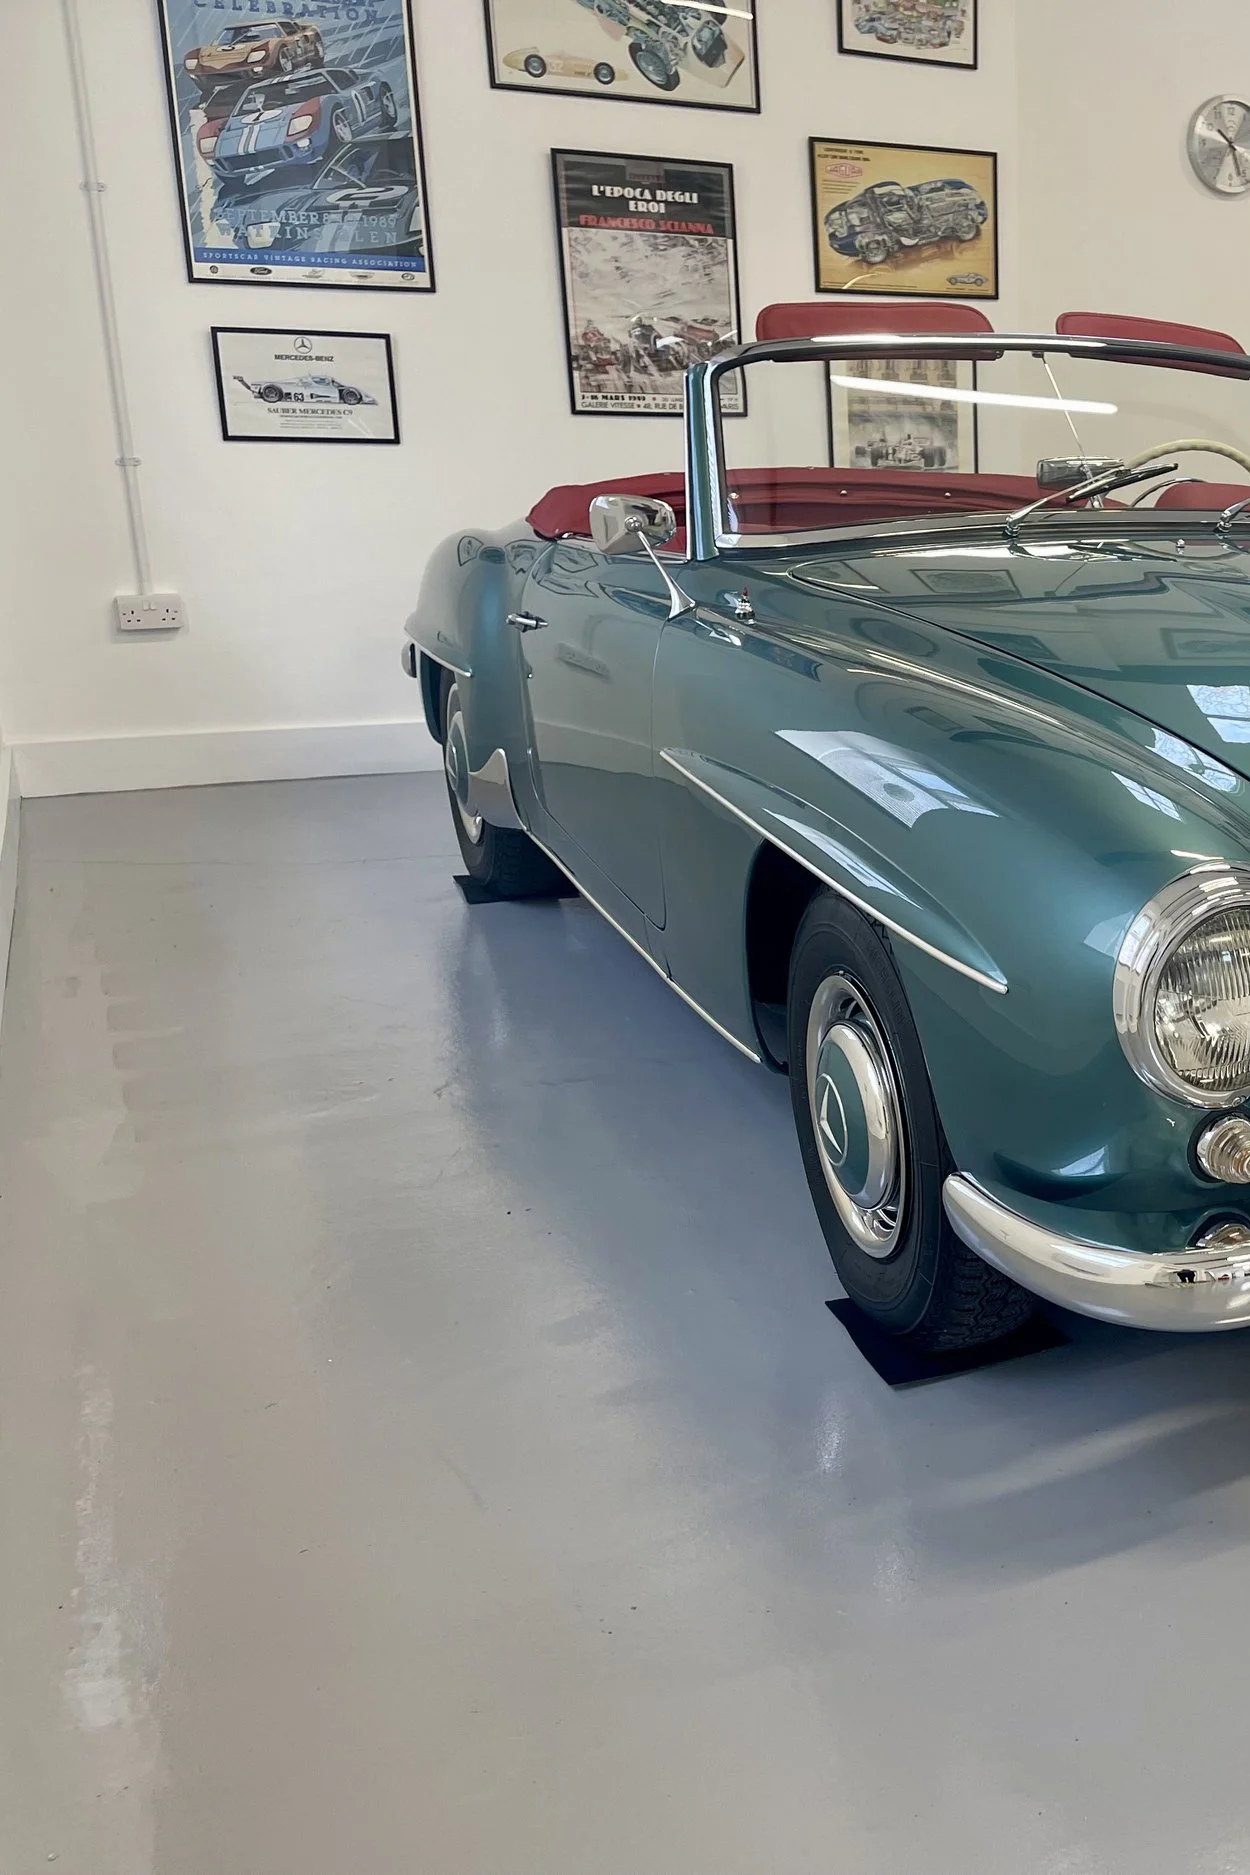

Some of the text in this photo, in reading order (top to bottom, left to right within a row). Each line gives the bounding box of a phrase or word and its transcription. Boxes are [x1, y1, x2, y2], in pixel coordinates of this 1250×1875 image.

[592, 184, 698, 204] L'EPOCA DEGLI
[628, 200, 666, 213] EROI
[362, 215, 397, 228] 1989
[579, 214, 714, 234] FRANCESCO SCIANNA
[202, 251, 417, 268] SPORTSCAR VINTAGE RACING ASSOCIATION
[274, 354, 334, 362] MERCEDES-BENZ
[299, 407, 342, 416] MERCEDES
[581, 401, 609, 409] GALERIE
[654, 402, 667, 410] RUE
